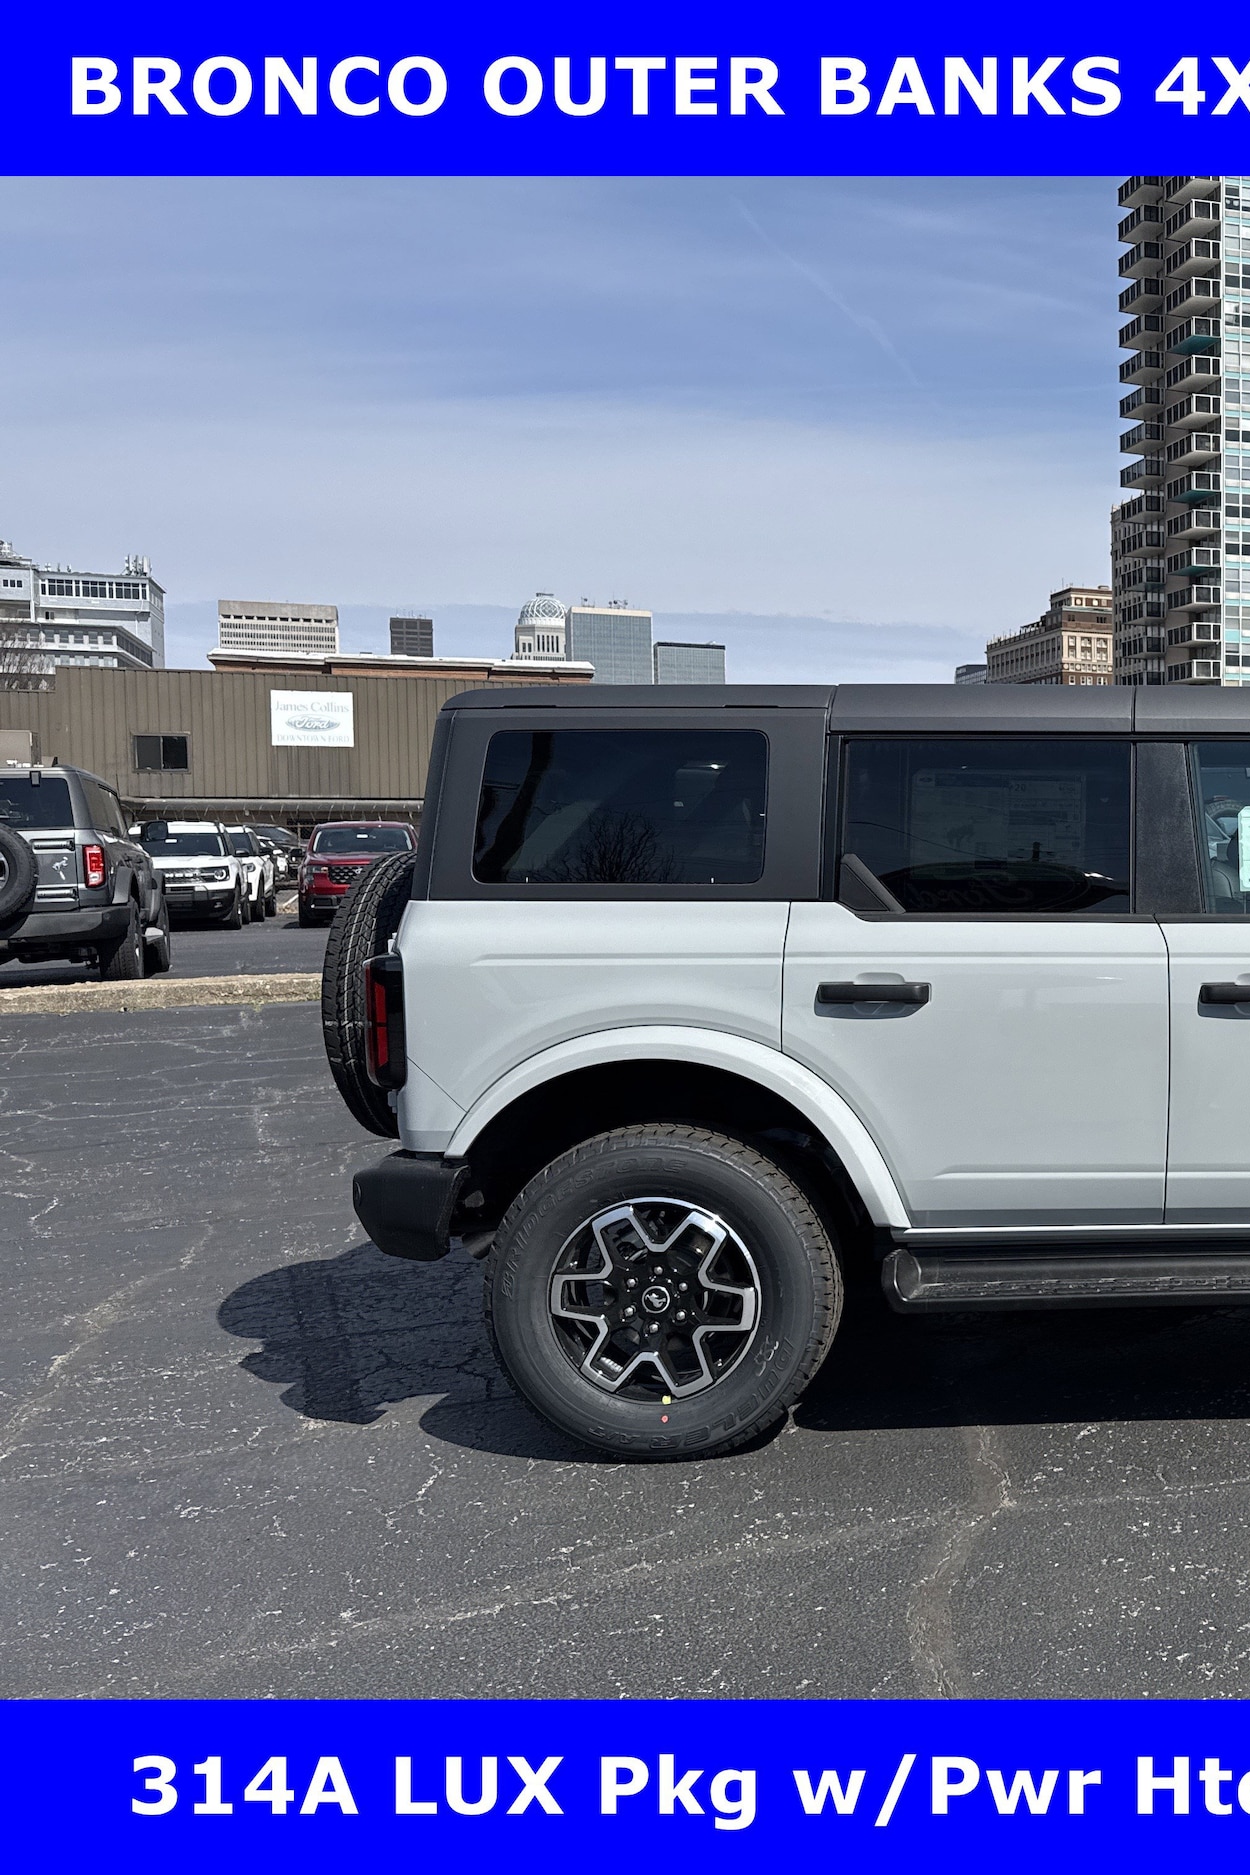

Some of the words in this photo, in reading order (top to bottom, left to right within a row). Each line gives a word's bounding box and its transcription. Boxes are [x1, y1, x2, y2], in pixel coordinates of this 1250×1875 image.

[274, 700, 308, 711] James
[311, 701, 349, 713] Collins
[295, 715, 330, 730] Ford
[276, 734, 326, 743] DOWNTOWN
[328, 735, 350, 743] FORD
